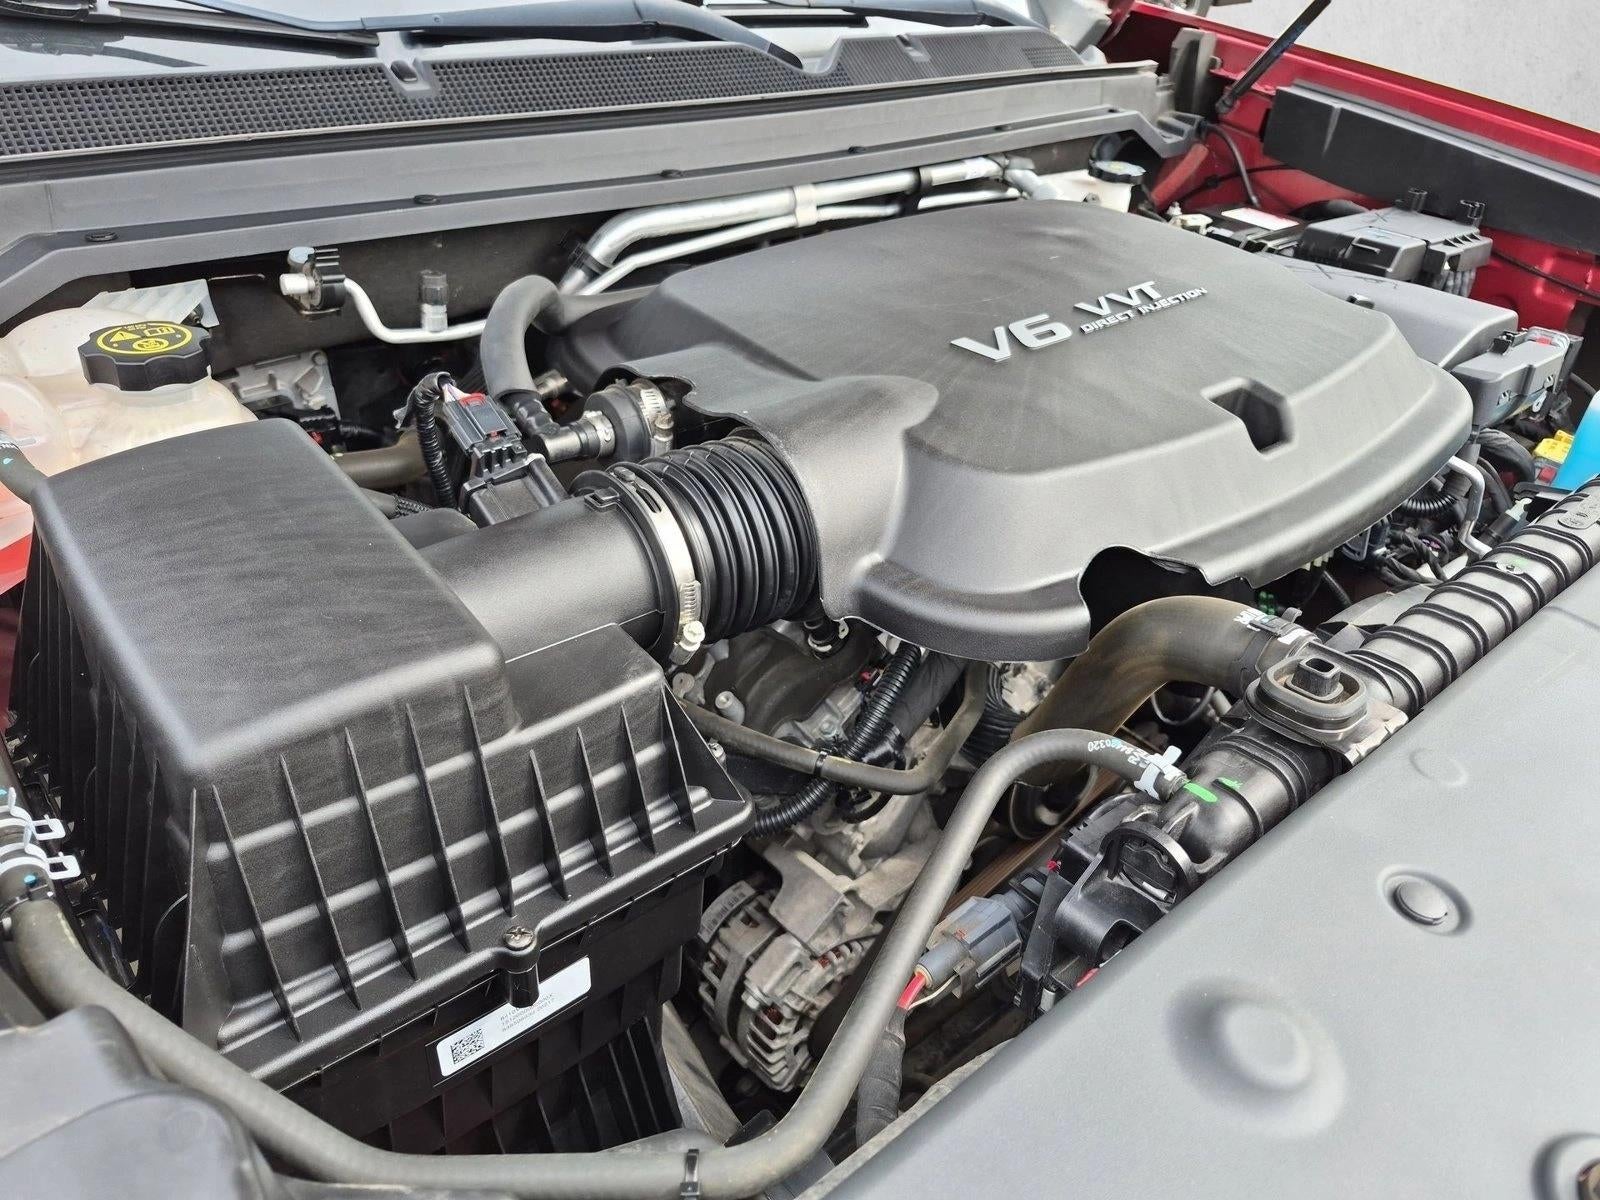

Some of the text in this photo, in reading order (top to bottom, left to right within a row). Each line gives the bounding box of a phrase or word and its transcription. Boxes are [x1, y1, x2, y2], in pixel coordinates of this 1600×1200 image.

[950, 281, 1162, 362] V6 VVT
[1080, 287, 1208, 334] DIRECT INJECTION
